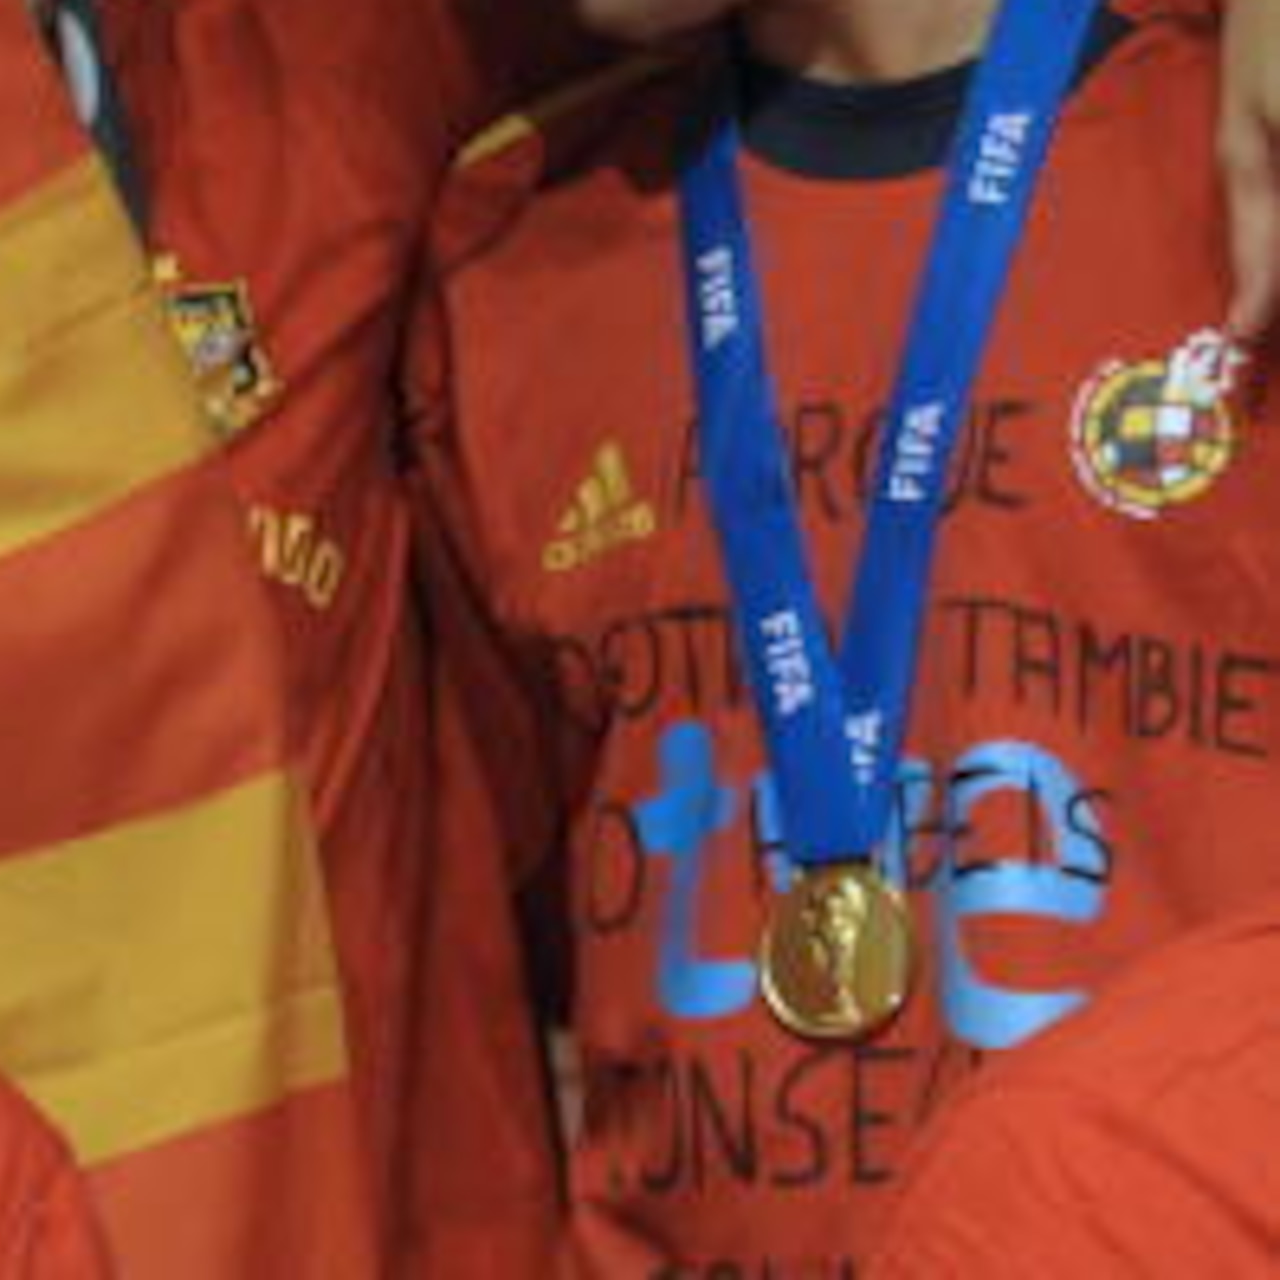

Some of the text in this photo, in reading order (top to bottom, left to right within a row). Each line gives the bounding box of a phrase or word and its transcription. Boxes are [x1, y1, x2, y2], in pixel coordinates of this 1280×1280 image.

[966, 114, 1030, 206] FIFA
[889, 402, 943, 502] FIFA
[761, 611, 815, 714] FIFA
